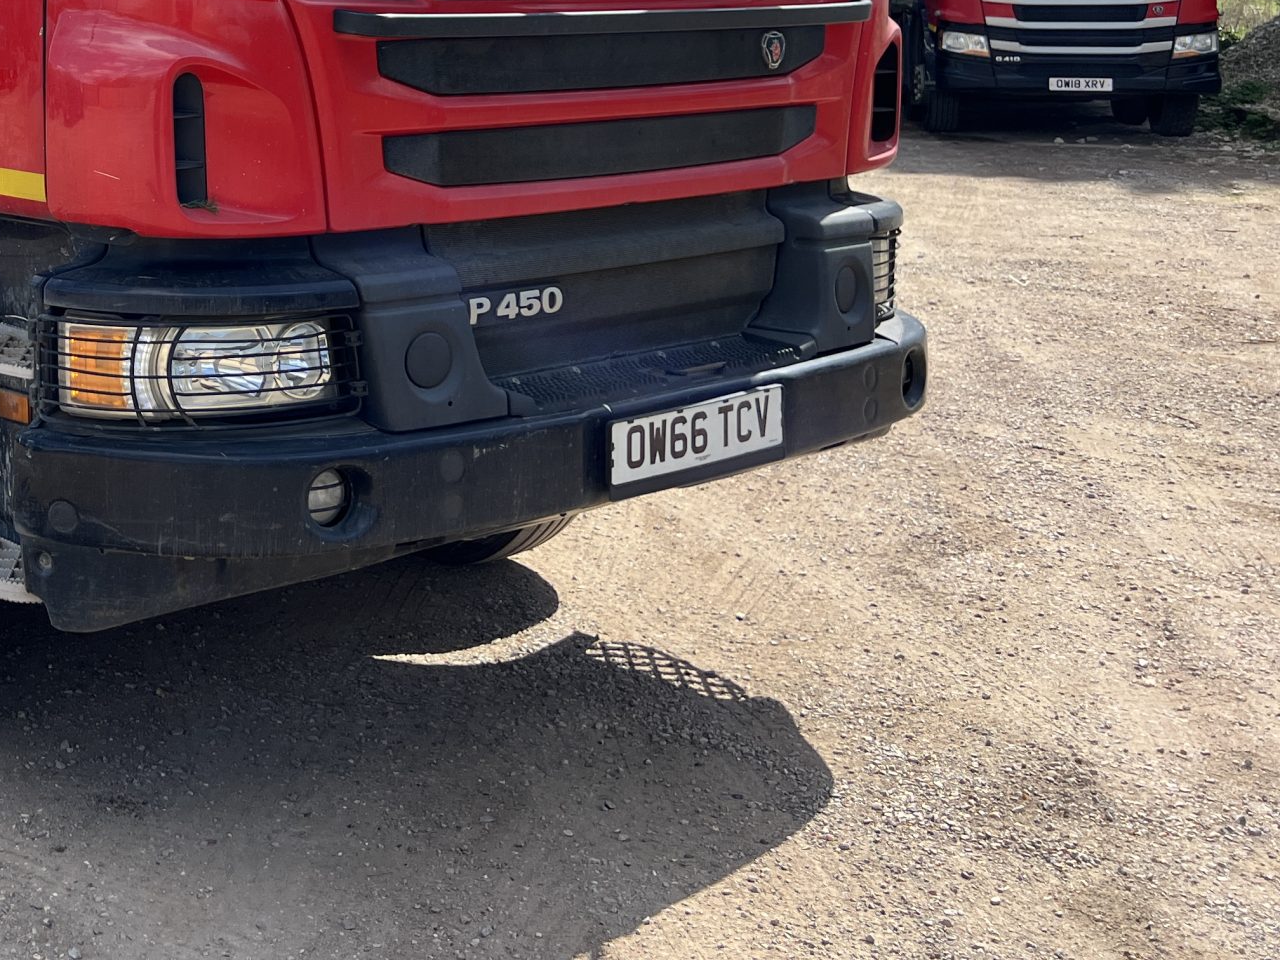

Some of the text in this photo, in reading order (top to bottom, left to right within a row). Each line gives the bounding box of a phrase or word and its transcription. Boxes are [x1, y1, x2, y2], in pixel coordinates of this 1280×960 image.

[1056, 79, 1105, 89] OW18 XRV
[469, 286, 563, 325] P 450
[627, 394, 770, 470] OW66 TCV
